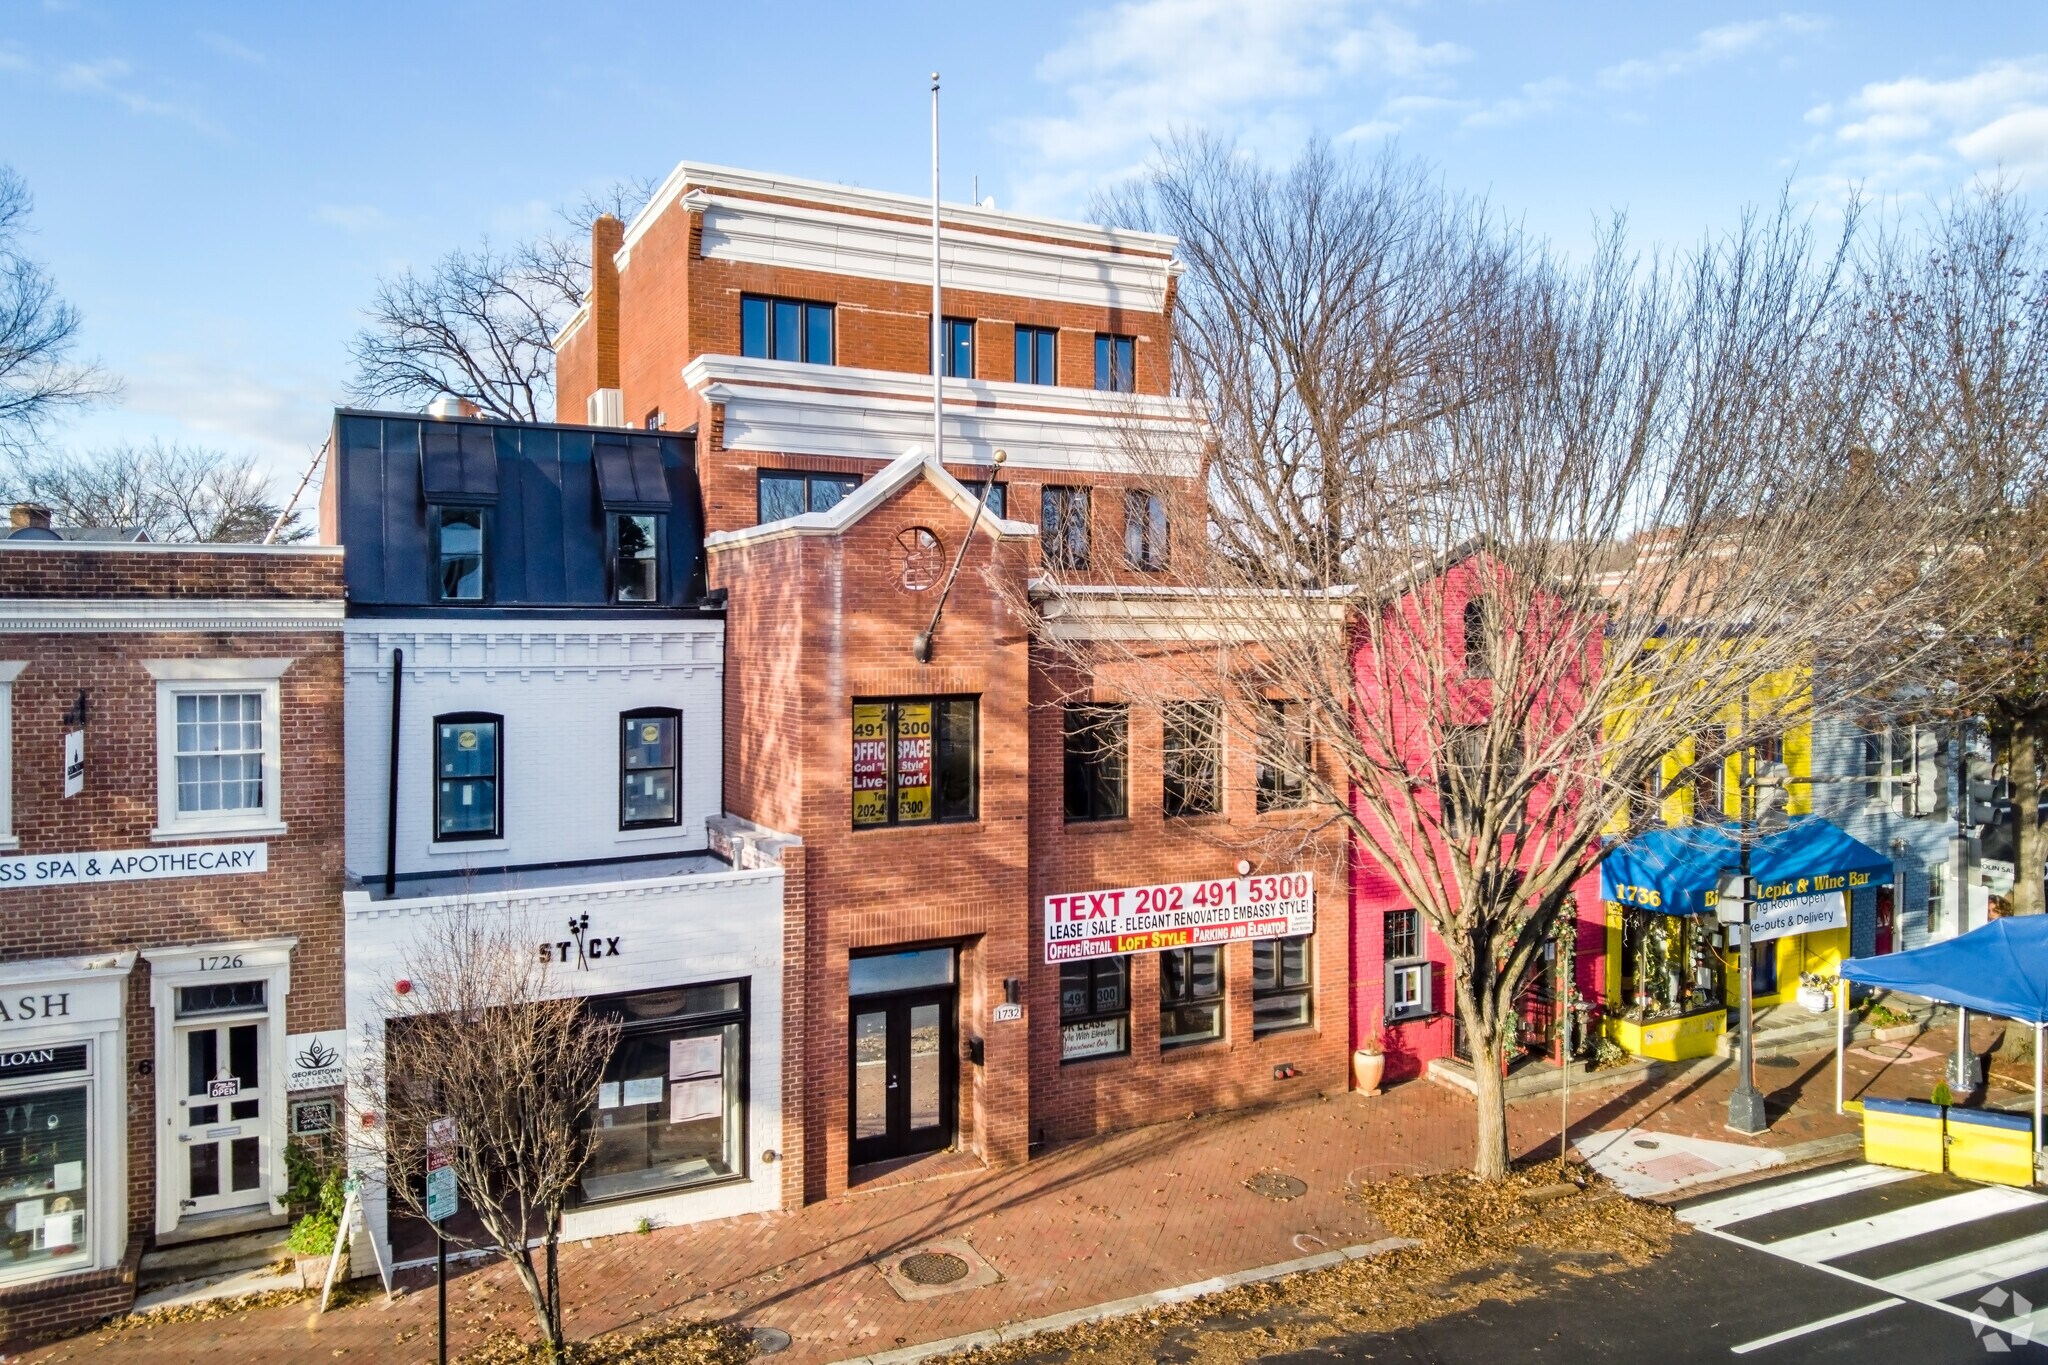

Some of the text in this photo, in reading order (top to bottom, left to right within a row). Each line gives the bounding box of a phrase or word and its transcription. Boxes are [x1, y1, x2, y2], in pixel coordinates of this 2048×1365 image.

[898, 722, 930, 735] 300
[854, 739, 930, 761] OFFIC SPACE
[854, 763, 875, 773] Cool
[36, 860, 77, 879] SPA
[86, 858, 101, 876] &
[110, 850, 256, 874] APOTHECARY
[1757, 871, 1871, 901] Lepic & Wine Bar
[1049, 875, 1307, 923] TEXT 202 491 5300
[1616, 883, 1661, 907] 1736
[1050, 923, 1083, 940] LEASE
[1092, 919, 1117, 936] SALE
[1126, 914, 1171, 931] ELEGANT
[1174, 907, 1230, 926] RENOVATED
[1233, 902, 1276, 920] EMBASSY
[1279, 900, 1309, 916] STYLE!
[1787, 915, 1794, 926] &
[1796, 910, 1834, 926] Delivery
[1230, 925, 1246, 938] AND
[199, 954, 243, 971] 1726
[998, 1008, 1019, 1020] 1732
[1076, 1031, 1090, 1041] With
[1091, 1028, 1116, 1039] Elevator
[1097, 1039, 1108, 1048] Only
[1, 1049, 54, 1067] LOAN
[291, 1067, 342, 1079] GEORGETOWN
[212, 1087, 236, 1097] OPEN
